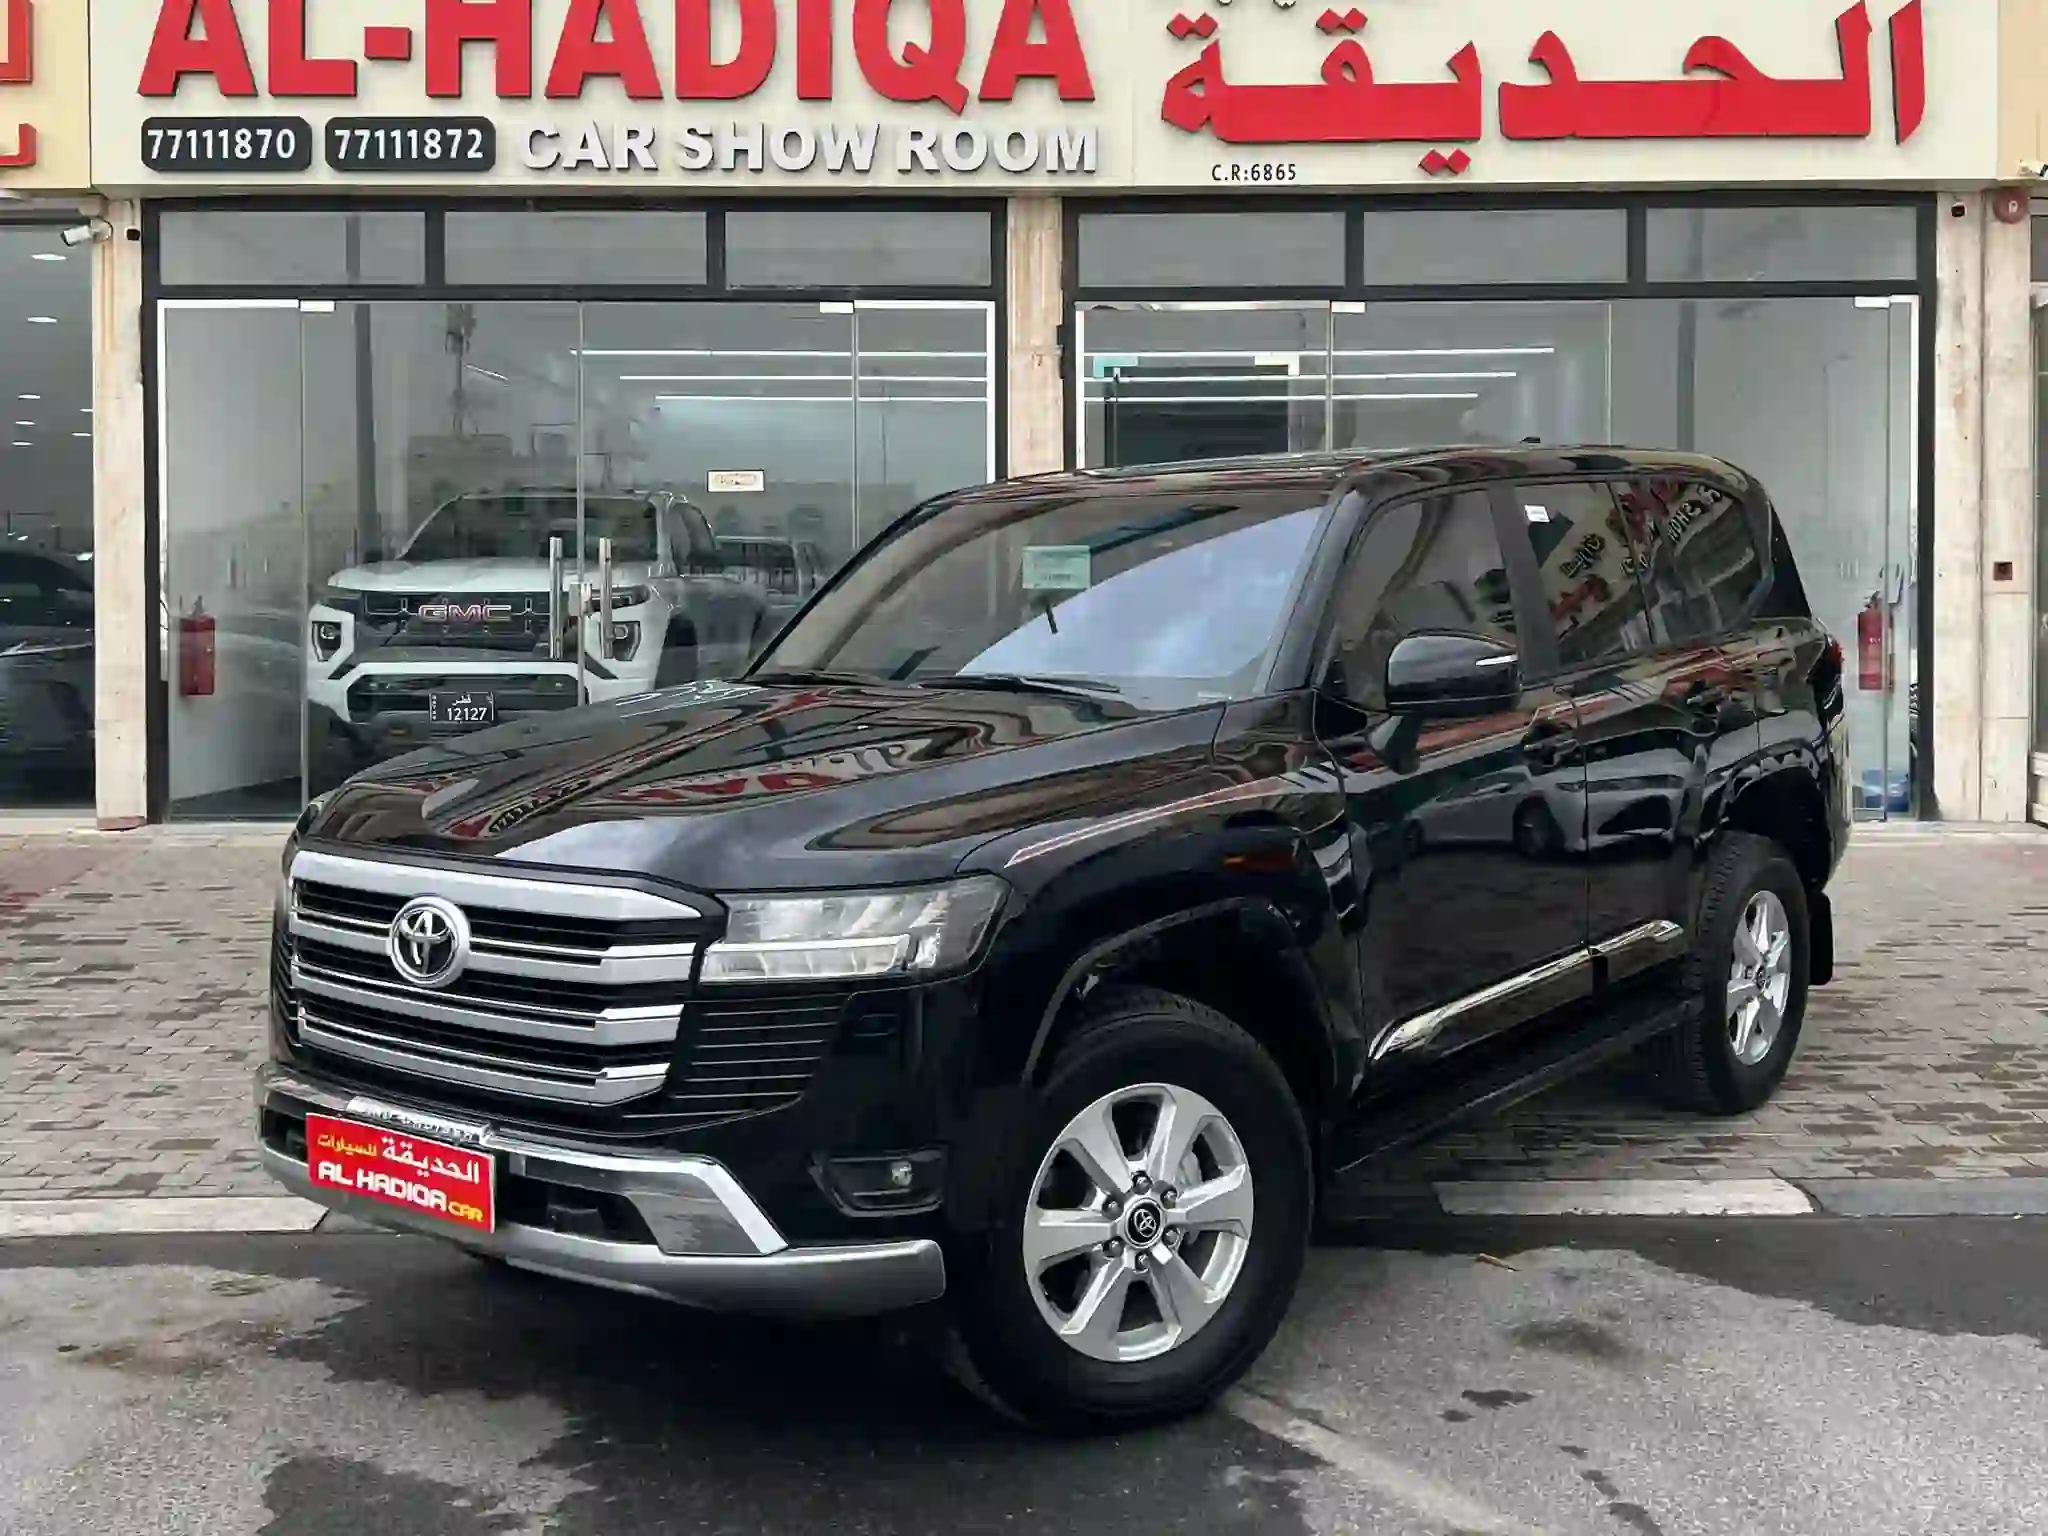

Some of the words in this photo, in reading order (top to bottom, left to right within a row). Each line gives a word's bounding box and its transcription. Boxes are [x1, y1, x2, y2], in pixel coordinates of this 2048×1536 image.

[138, 0, 1095, 116] AL-HADIQA
[1160, 0, 1926, 176] الحديقة
[147, 129, 297, 160] 77111870
[334, 128, 484, 160] 77111872
[522, 120, 659, 172] CAR
[677, 120, 882, 174] SHOW
[897, 122, 1097, 174] ROOM
[1210, 163, 1298, 182] C.R:6865
[418, 604, 512, 623] GMC
[447, 707, 487, 721] 12127
[451, 694, 472, 706] قطر
[317, 1132, 377, 1157] للسيارات
[381, 1136, 480, 1184] الحديقة
[318, 1161, 354, 1186] AL
[447, 1200, 484, 1223] CAR
